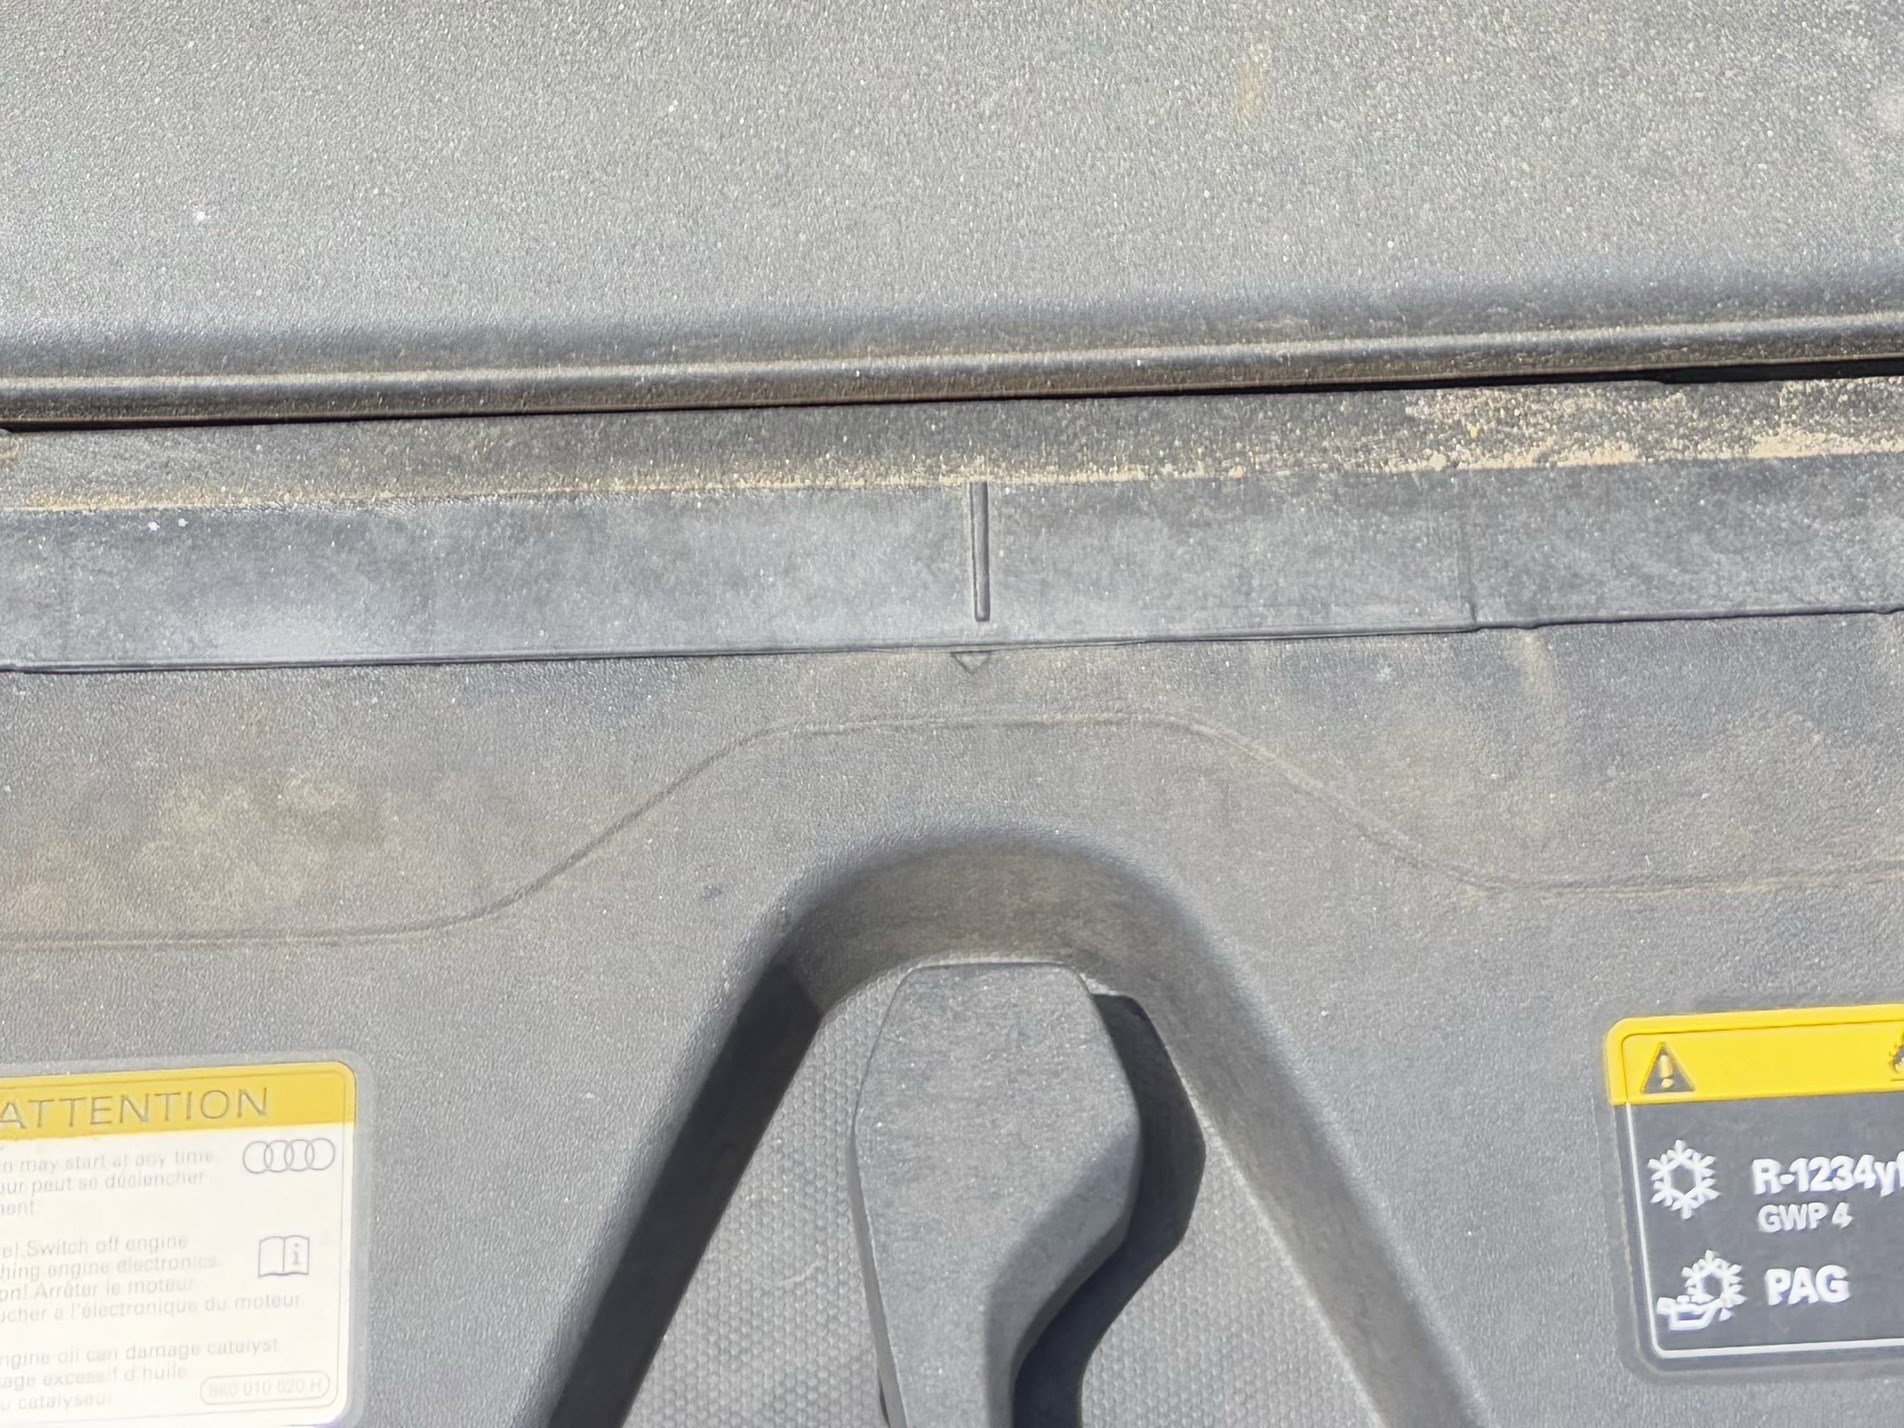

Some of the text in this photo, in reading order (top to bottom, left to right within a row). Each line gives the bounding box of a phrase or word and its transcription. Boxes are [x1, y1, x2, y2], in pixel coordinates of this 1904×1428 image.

[20, 1159, 58, 1174] may
[65, 1155, 106, 1171] start
[32, 1177, 73, 1198] peut
[78, 1178, 98, 1192] se
[104, 1170, 205, 1191] déclencher
[1757, 1201, 1855, 1233] GWP 4
[26, 1237, 89, 1259] Switch
[95, 1235, 120, 1253] off
[125, 1235, 189, 1254] engine
[47, 1260, 110, 1280] engine
[34, 1280, 99, 1301] Arrêter
[105, 1279, 121, 1297] le
[1763, 1264, 1852, 1307] PAG
[71, 1296, 198, 1322] l'électronique
[204, 1293, 228, 1312] du
[57, 1346, 80, 1366] oil
[86, 1347, 119, 1364] can
[125, 1342, 201, 1365] damage
[42, 1366, 120, 1388] excessif
[124, 1364, 189, 1383] d'huile
[243, 1380, 272, 1397] 010
